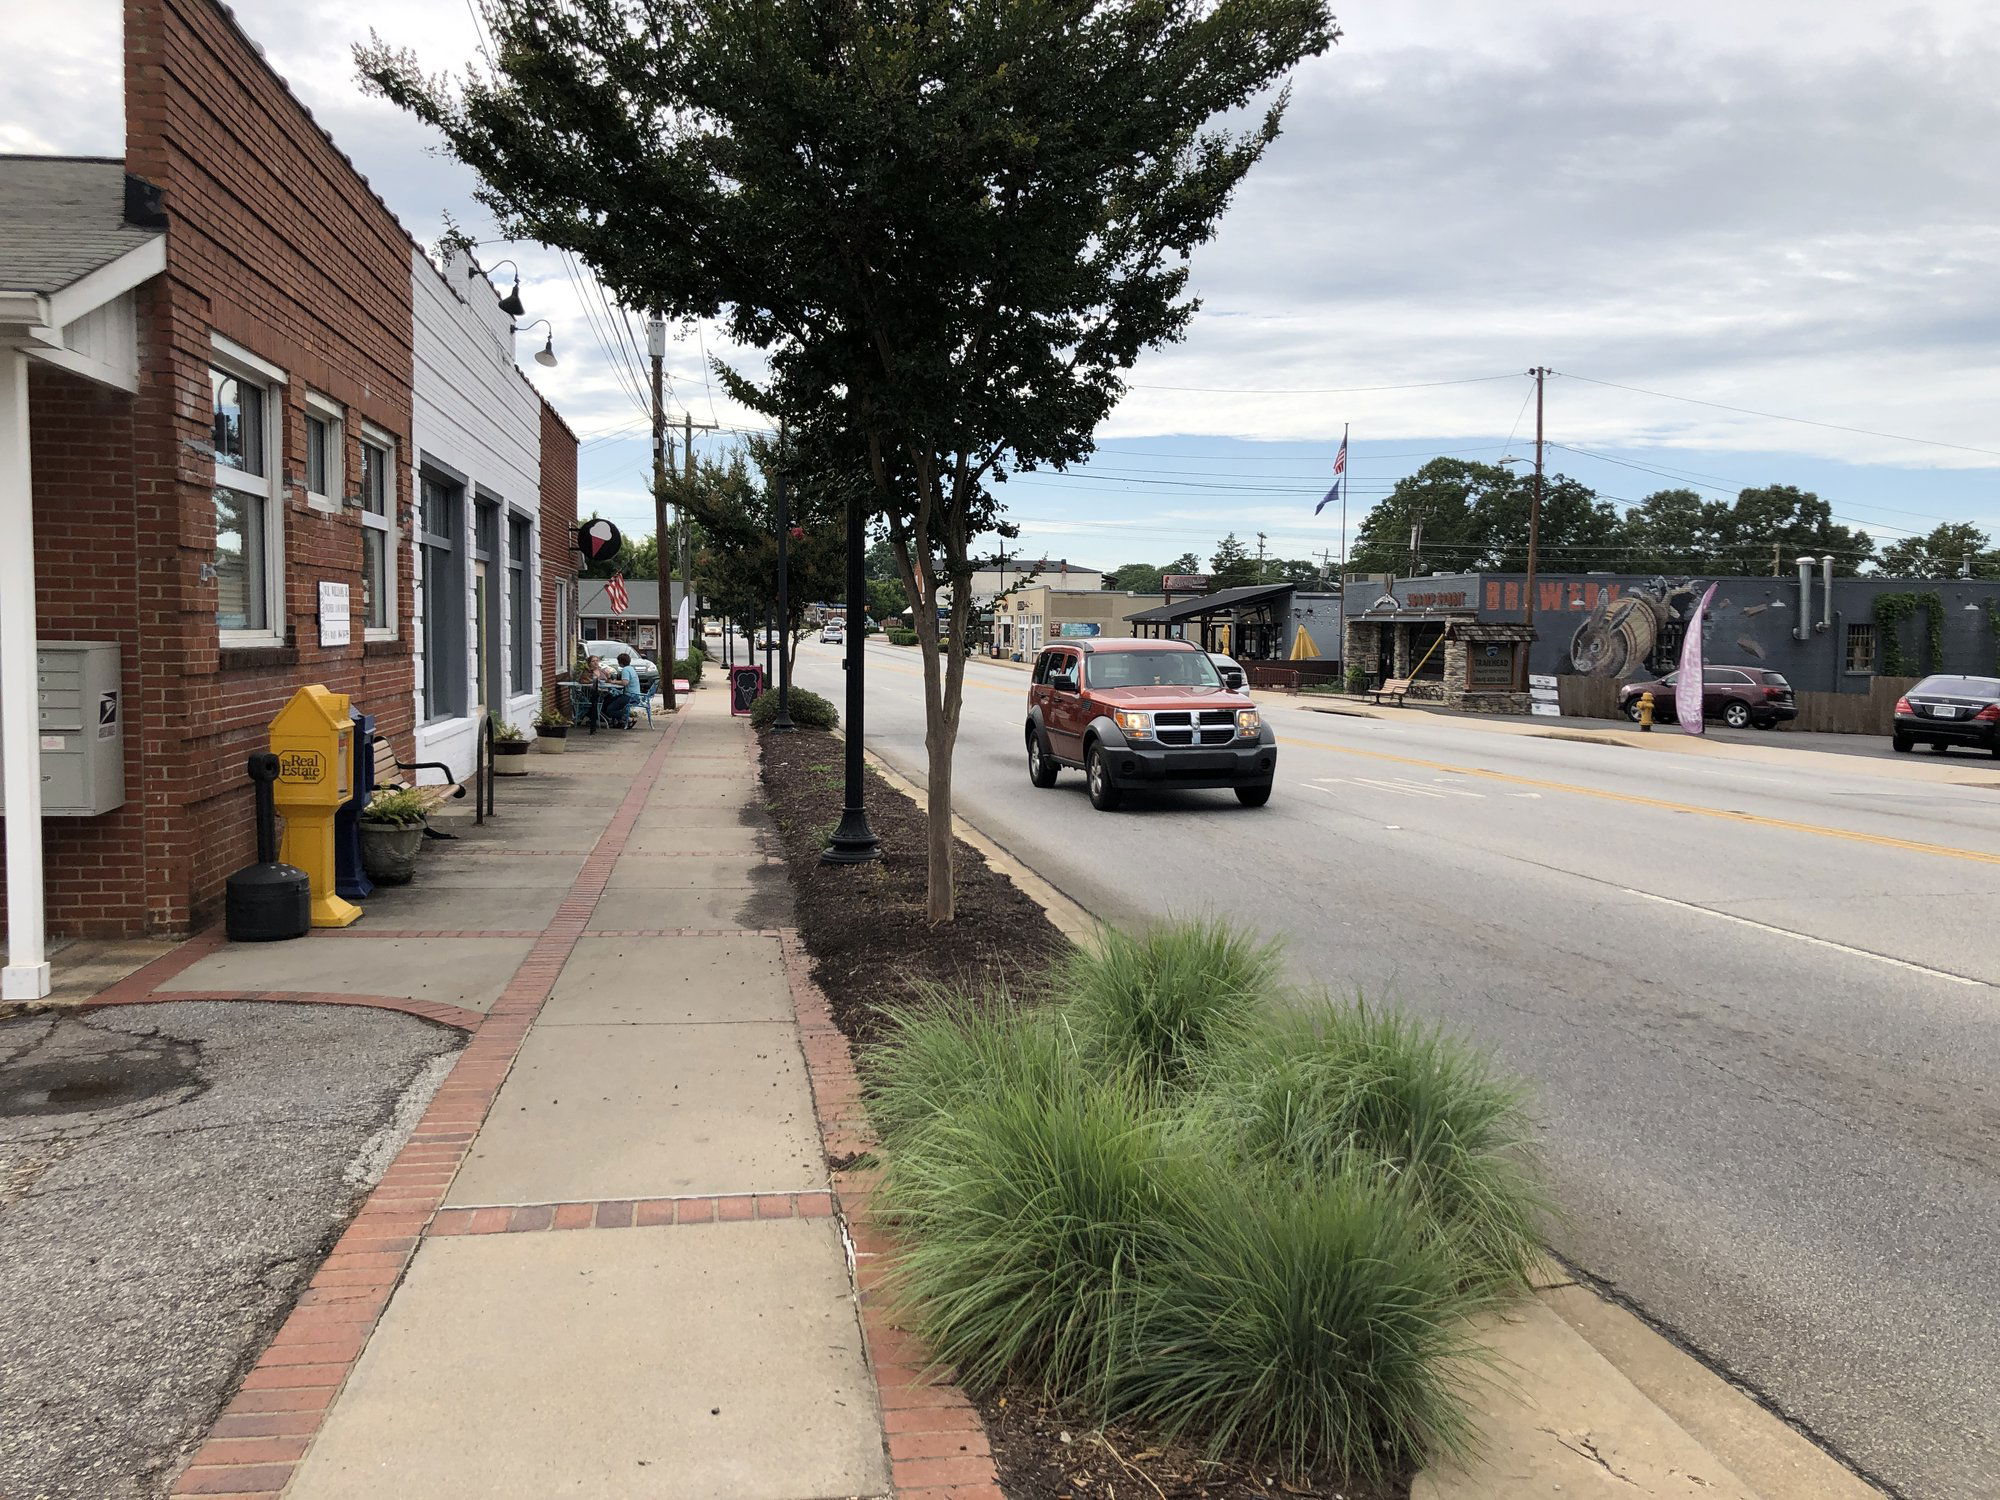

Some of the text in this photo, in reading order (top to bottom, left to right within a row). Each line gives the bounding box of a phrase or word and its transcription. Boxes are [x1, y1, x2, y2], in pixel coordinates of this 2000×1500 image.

[1486, 581, 1620, 612] BRWERY
[1475, 659, 1509, 667] TRAILHEAD
[291, 755, 318, 767] Real
[282, 765, 320, 777] Estate
